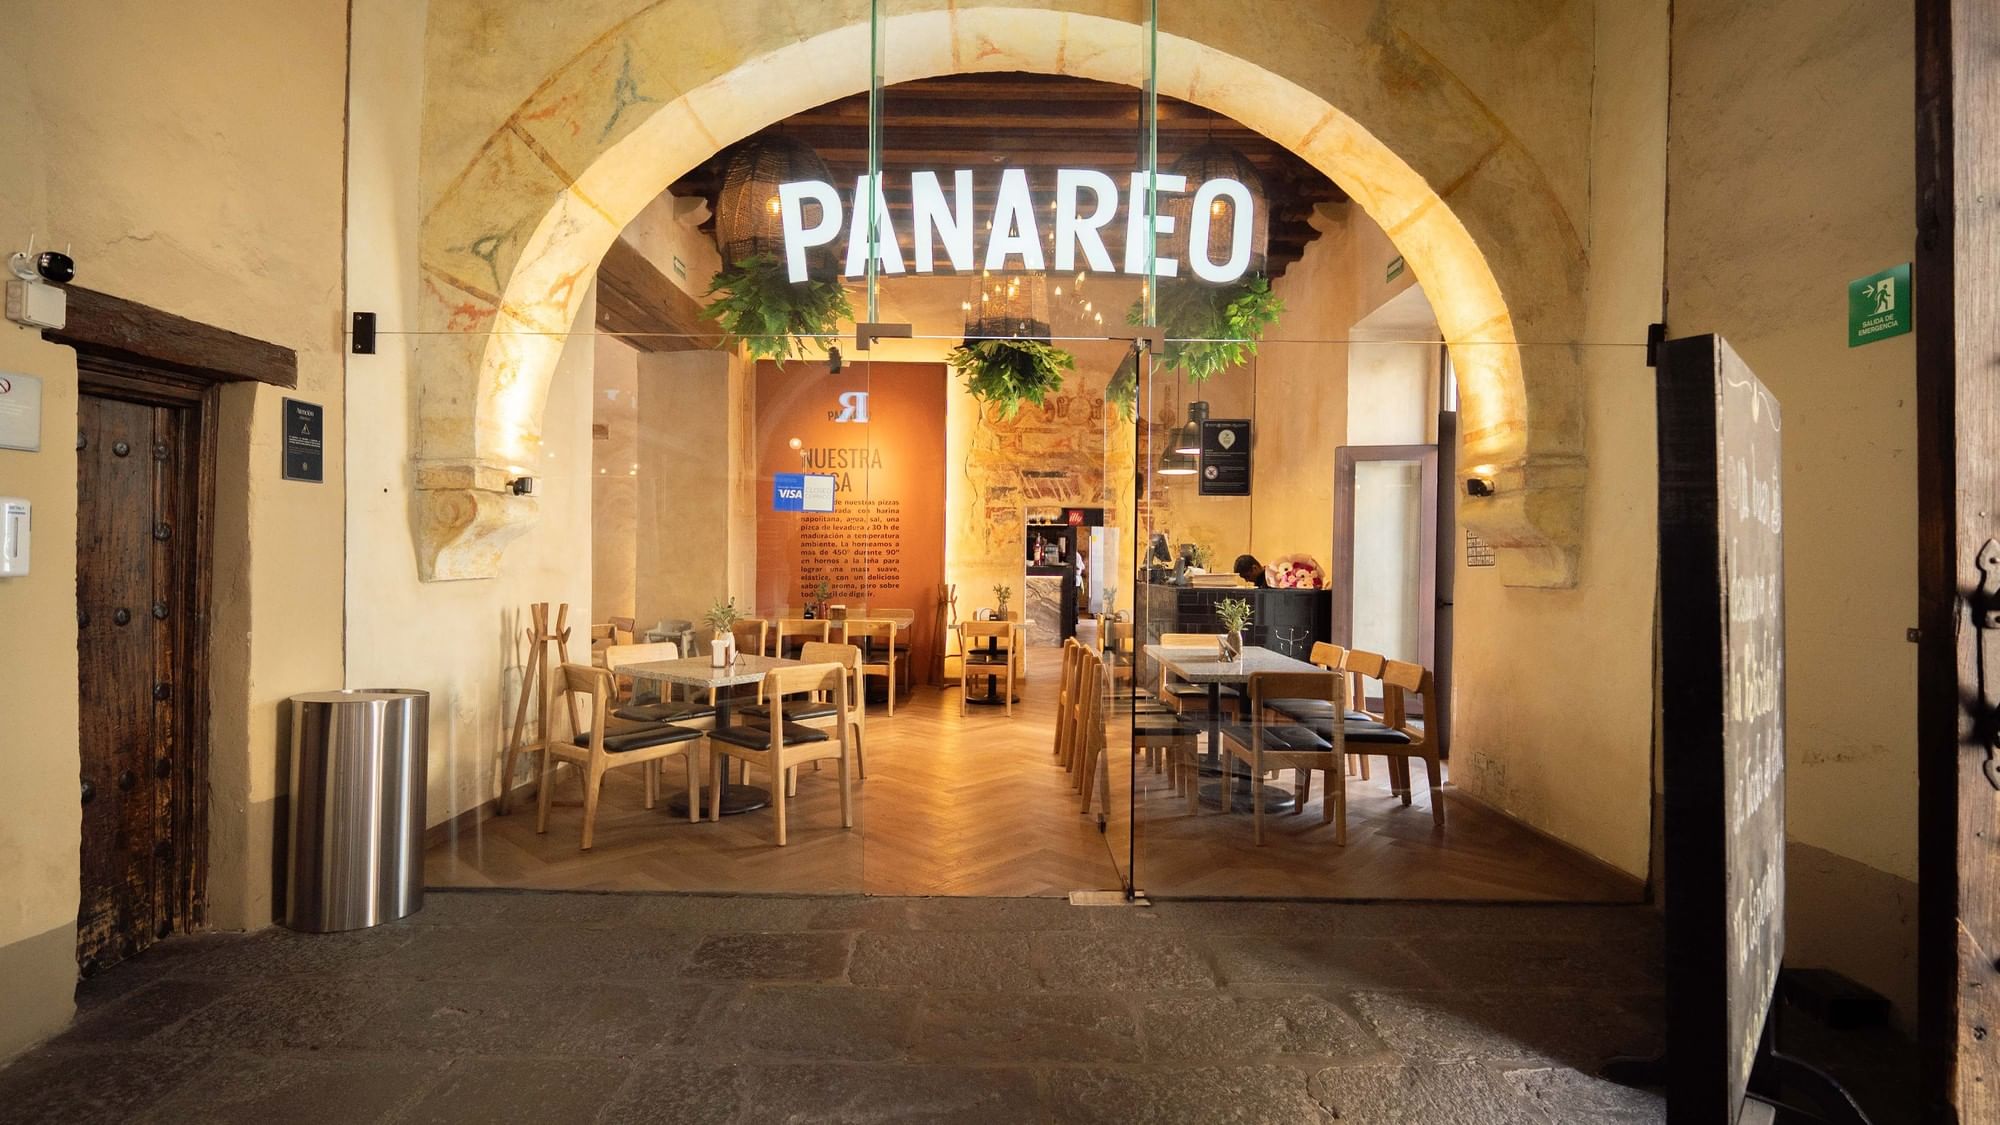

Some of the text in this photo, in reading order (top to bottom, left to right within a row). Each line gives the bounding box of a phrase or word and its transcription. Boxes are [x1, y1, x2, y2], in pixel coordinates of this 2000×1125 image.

[778, 168, 1254, 283] PANAREO
[1858, 320, 1899, 336] EMERGENCIA
[1862, 313, 1894, 328] SALIDA DE
[803, 448, 882, 469] NUESTRA
[778, 488, 802, 499] VISA
[877, 499, 900, 507] pizzas
[1069, 512, 1083, 525] illy
